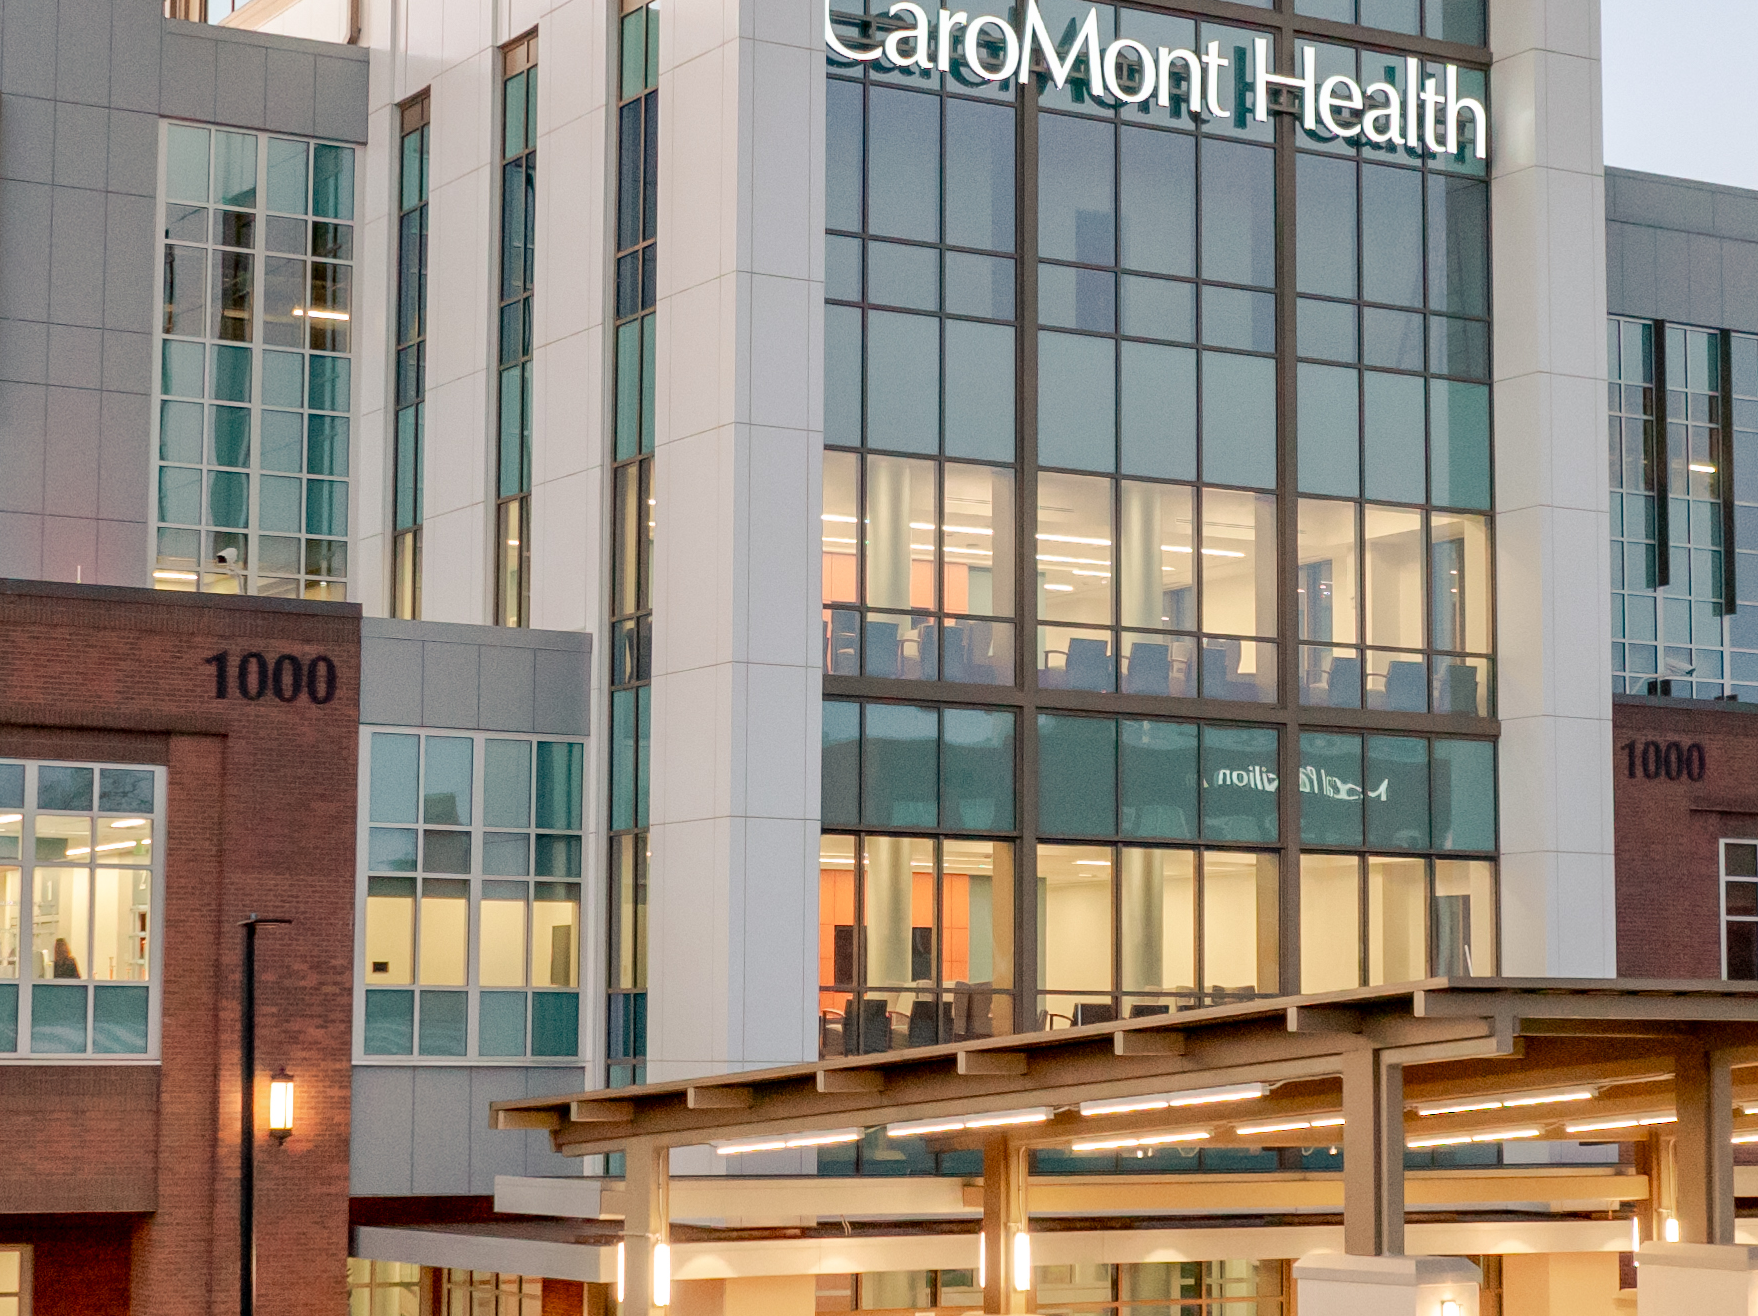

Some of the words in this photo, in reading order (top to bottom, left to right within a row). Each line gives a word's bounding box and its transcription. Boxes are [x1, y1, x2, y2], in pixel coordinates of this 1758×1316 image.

[1253, 37, 1487, 159] Health
[203, 650, 338, 705] 1000
[1620, 740, 1706, 782] 1000
